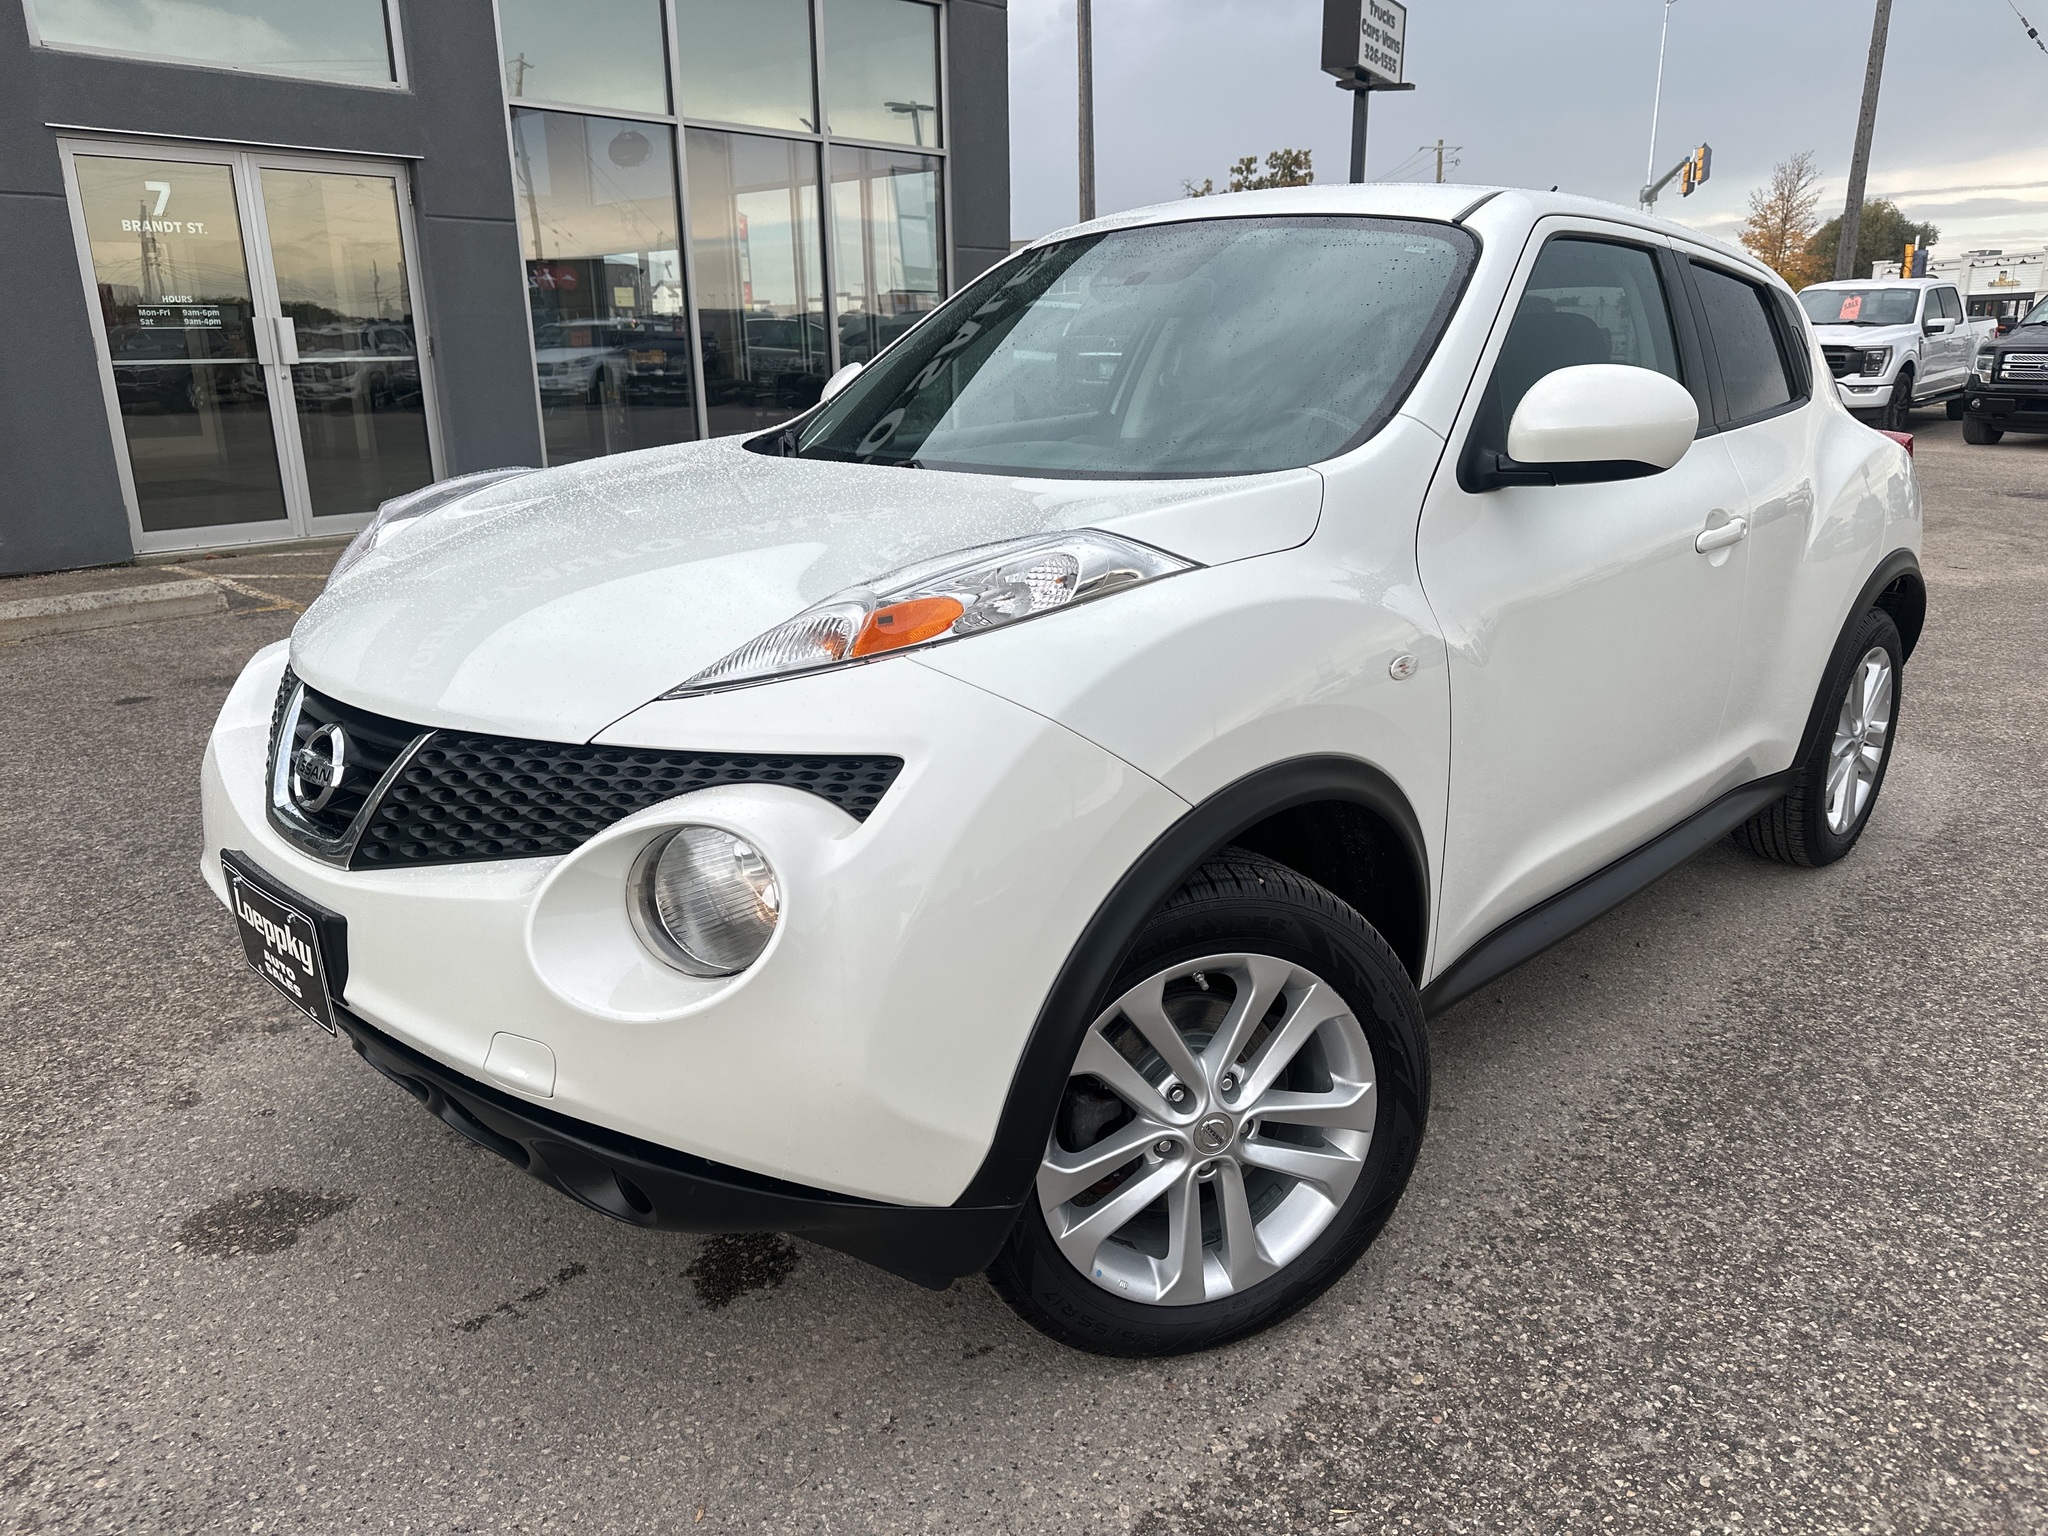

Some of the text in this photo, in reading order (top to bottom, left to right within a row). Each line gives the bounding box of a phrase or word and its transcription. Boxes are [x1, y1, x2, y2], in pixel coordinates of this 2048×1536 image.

[1369, 0, 1396, 29] Trucks
[144, 180, 171, 217] 7
[121, 219, 208, 235] BRANDT ST.
[161, 295, 193, 303] HOURS
[1843, 300, 1859, 310] SALE
[140, 318, 221, 326] Sat 9am-4pm
[182, 309, 220, 317] 9am-6pm
[233, 886, 314, 977] Loeppky
[263, 949, 296, 981] AUTO
[264, 961, 303, 999] SALES
